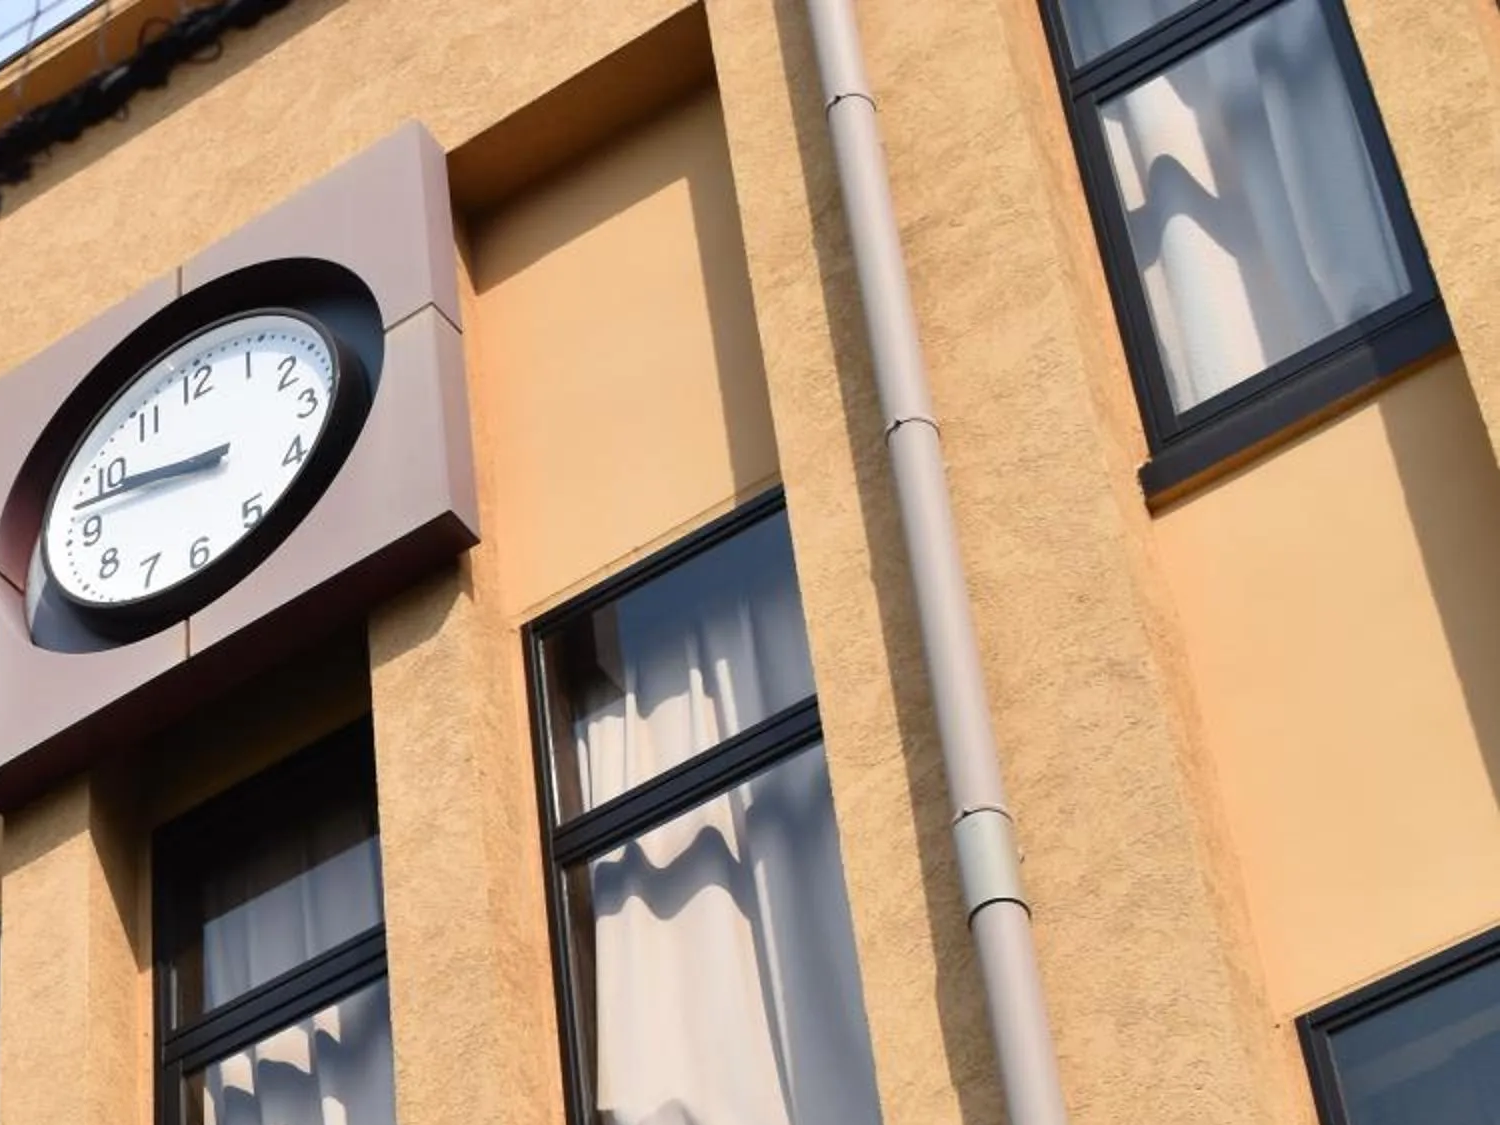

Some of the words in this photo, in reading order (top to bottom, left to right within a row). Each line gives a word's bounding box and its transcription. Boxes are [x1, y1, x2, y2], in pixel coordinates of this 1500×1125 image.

[183, 365, 214, 405] 12
[277, 356, 298, 391] 2
[297, 388, 319, 419] 3
[139, 405, 160, 442] 11
[281, 435, 307, 467] 4
[97, 457, 127, 496] 10
[242, 493, 264, 529] 5
[82, 515, 103, 547] 9
[99, 547, 120, 579] 8
[140, 553, 162, 588] 7
[189, 537, 211, 570] 6
